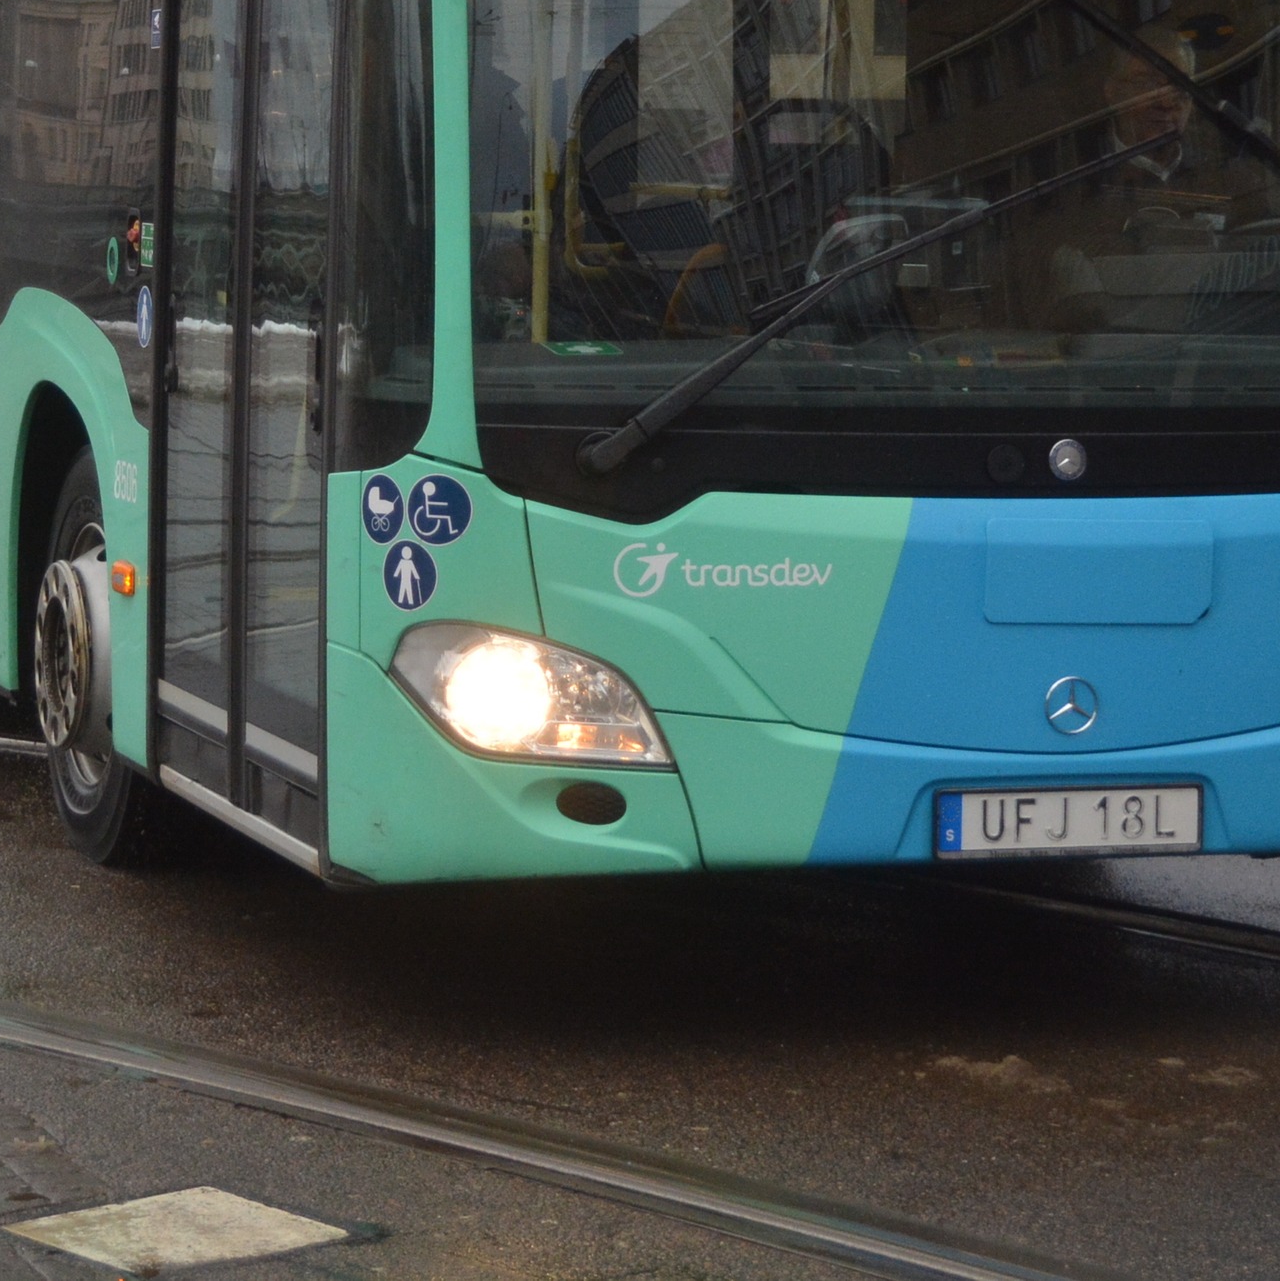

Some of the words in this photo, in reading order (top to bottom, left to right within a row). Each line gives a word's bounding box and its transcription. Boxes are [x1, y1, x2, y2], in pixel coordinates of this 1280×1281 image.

[114, 460, 138, 503] 8506
[681, 557, 832, 586] transdev
[945, 829, 955, 842] S
[981, 796, 1068, 843] UFJ
[1093, 793, 1175, 839] 18L
